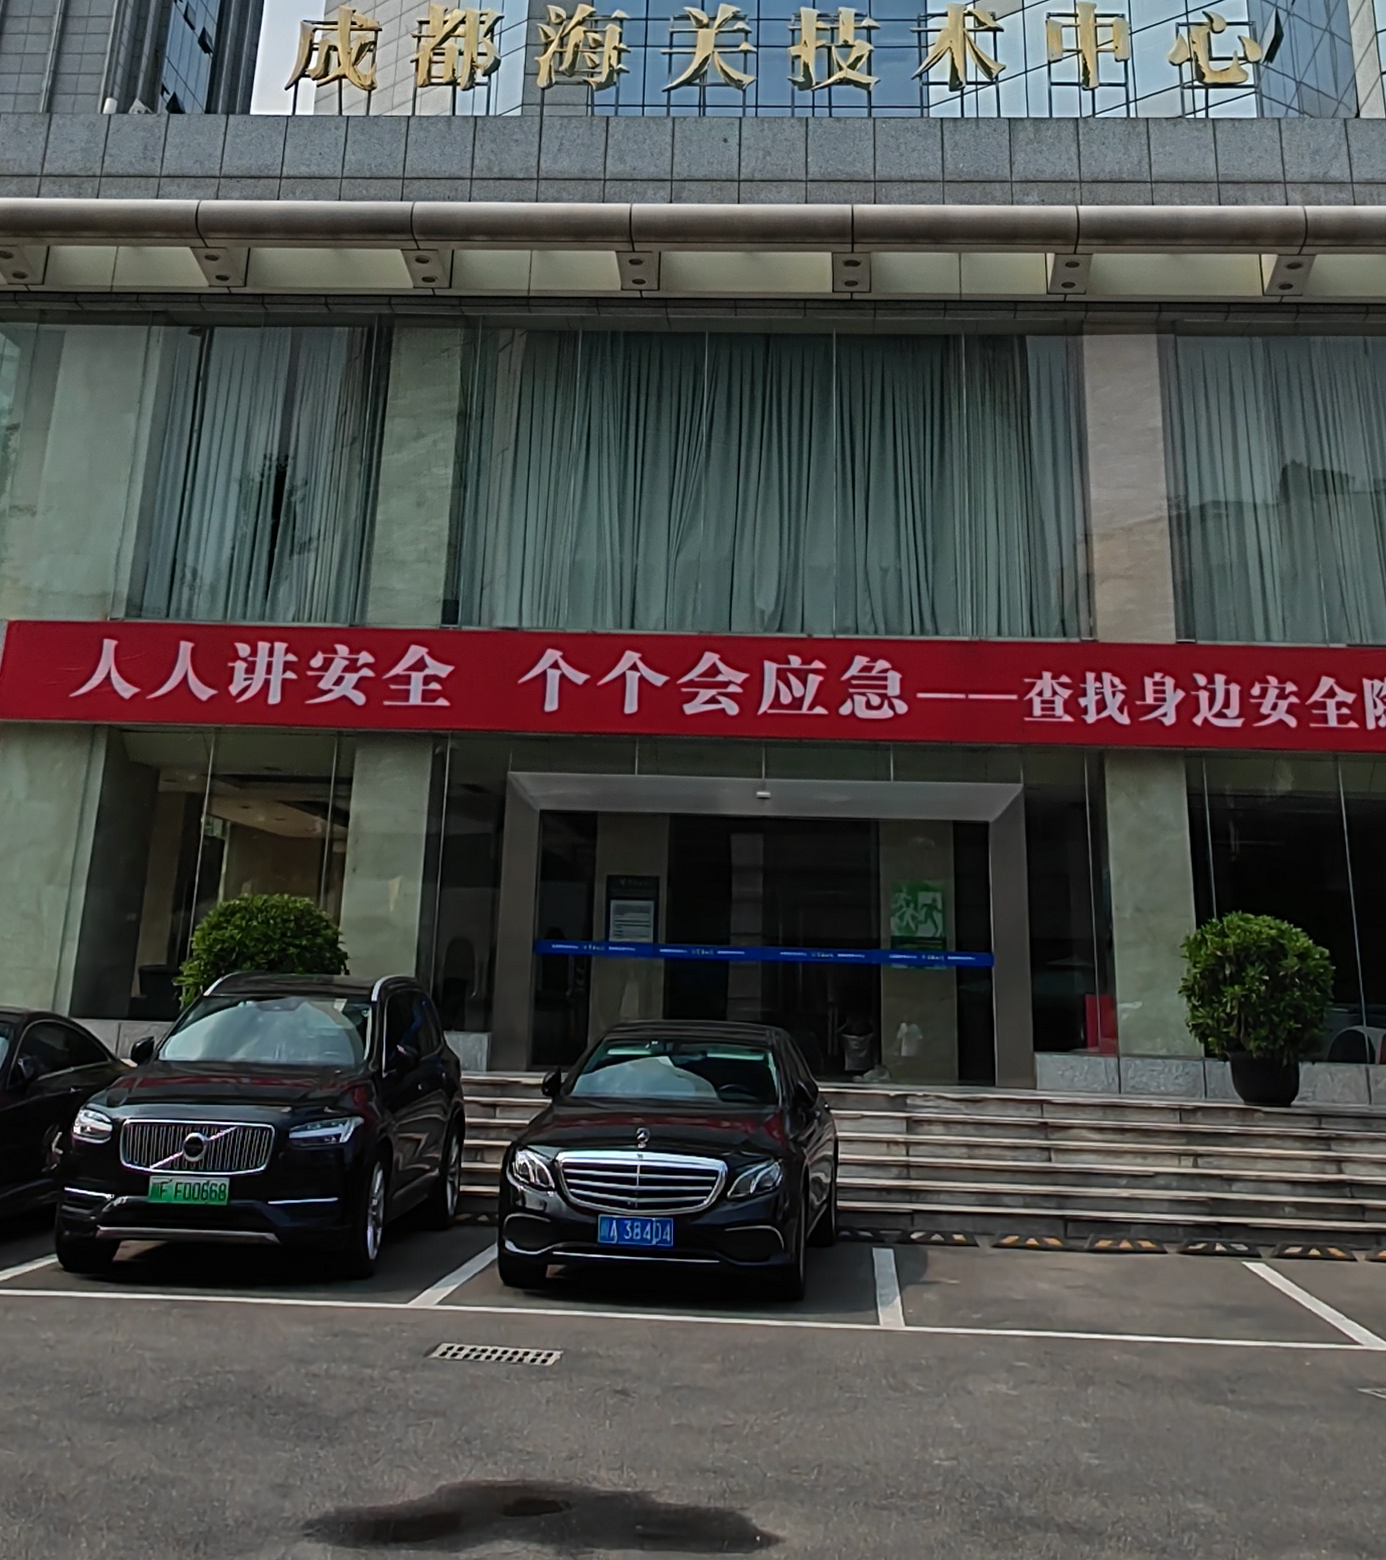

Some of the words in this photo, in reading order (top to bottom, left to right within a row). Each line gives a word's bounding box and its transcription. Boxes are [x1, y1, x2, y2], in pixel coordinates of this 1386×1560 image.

[284, 3, 1262, 92] 成都海关技术中心
[69, 638, 456, 707] 人人讲安全
